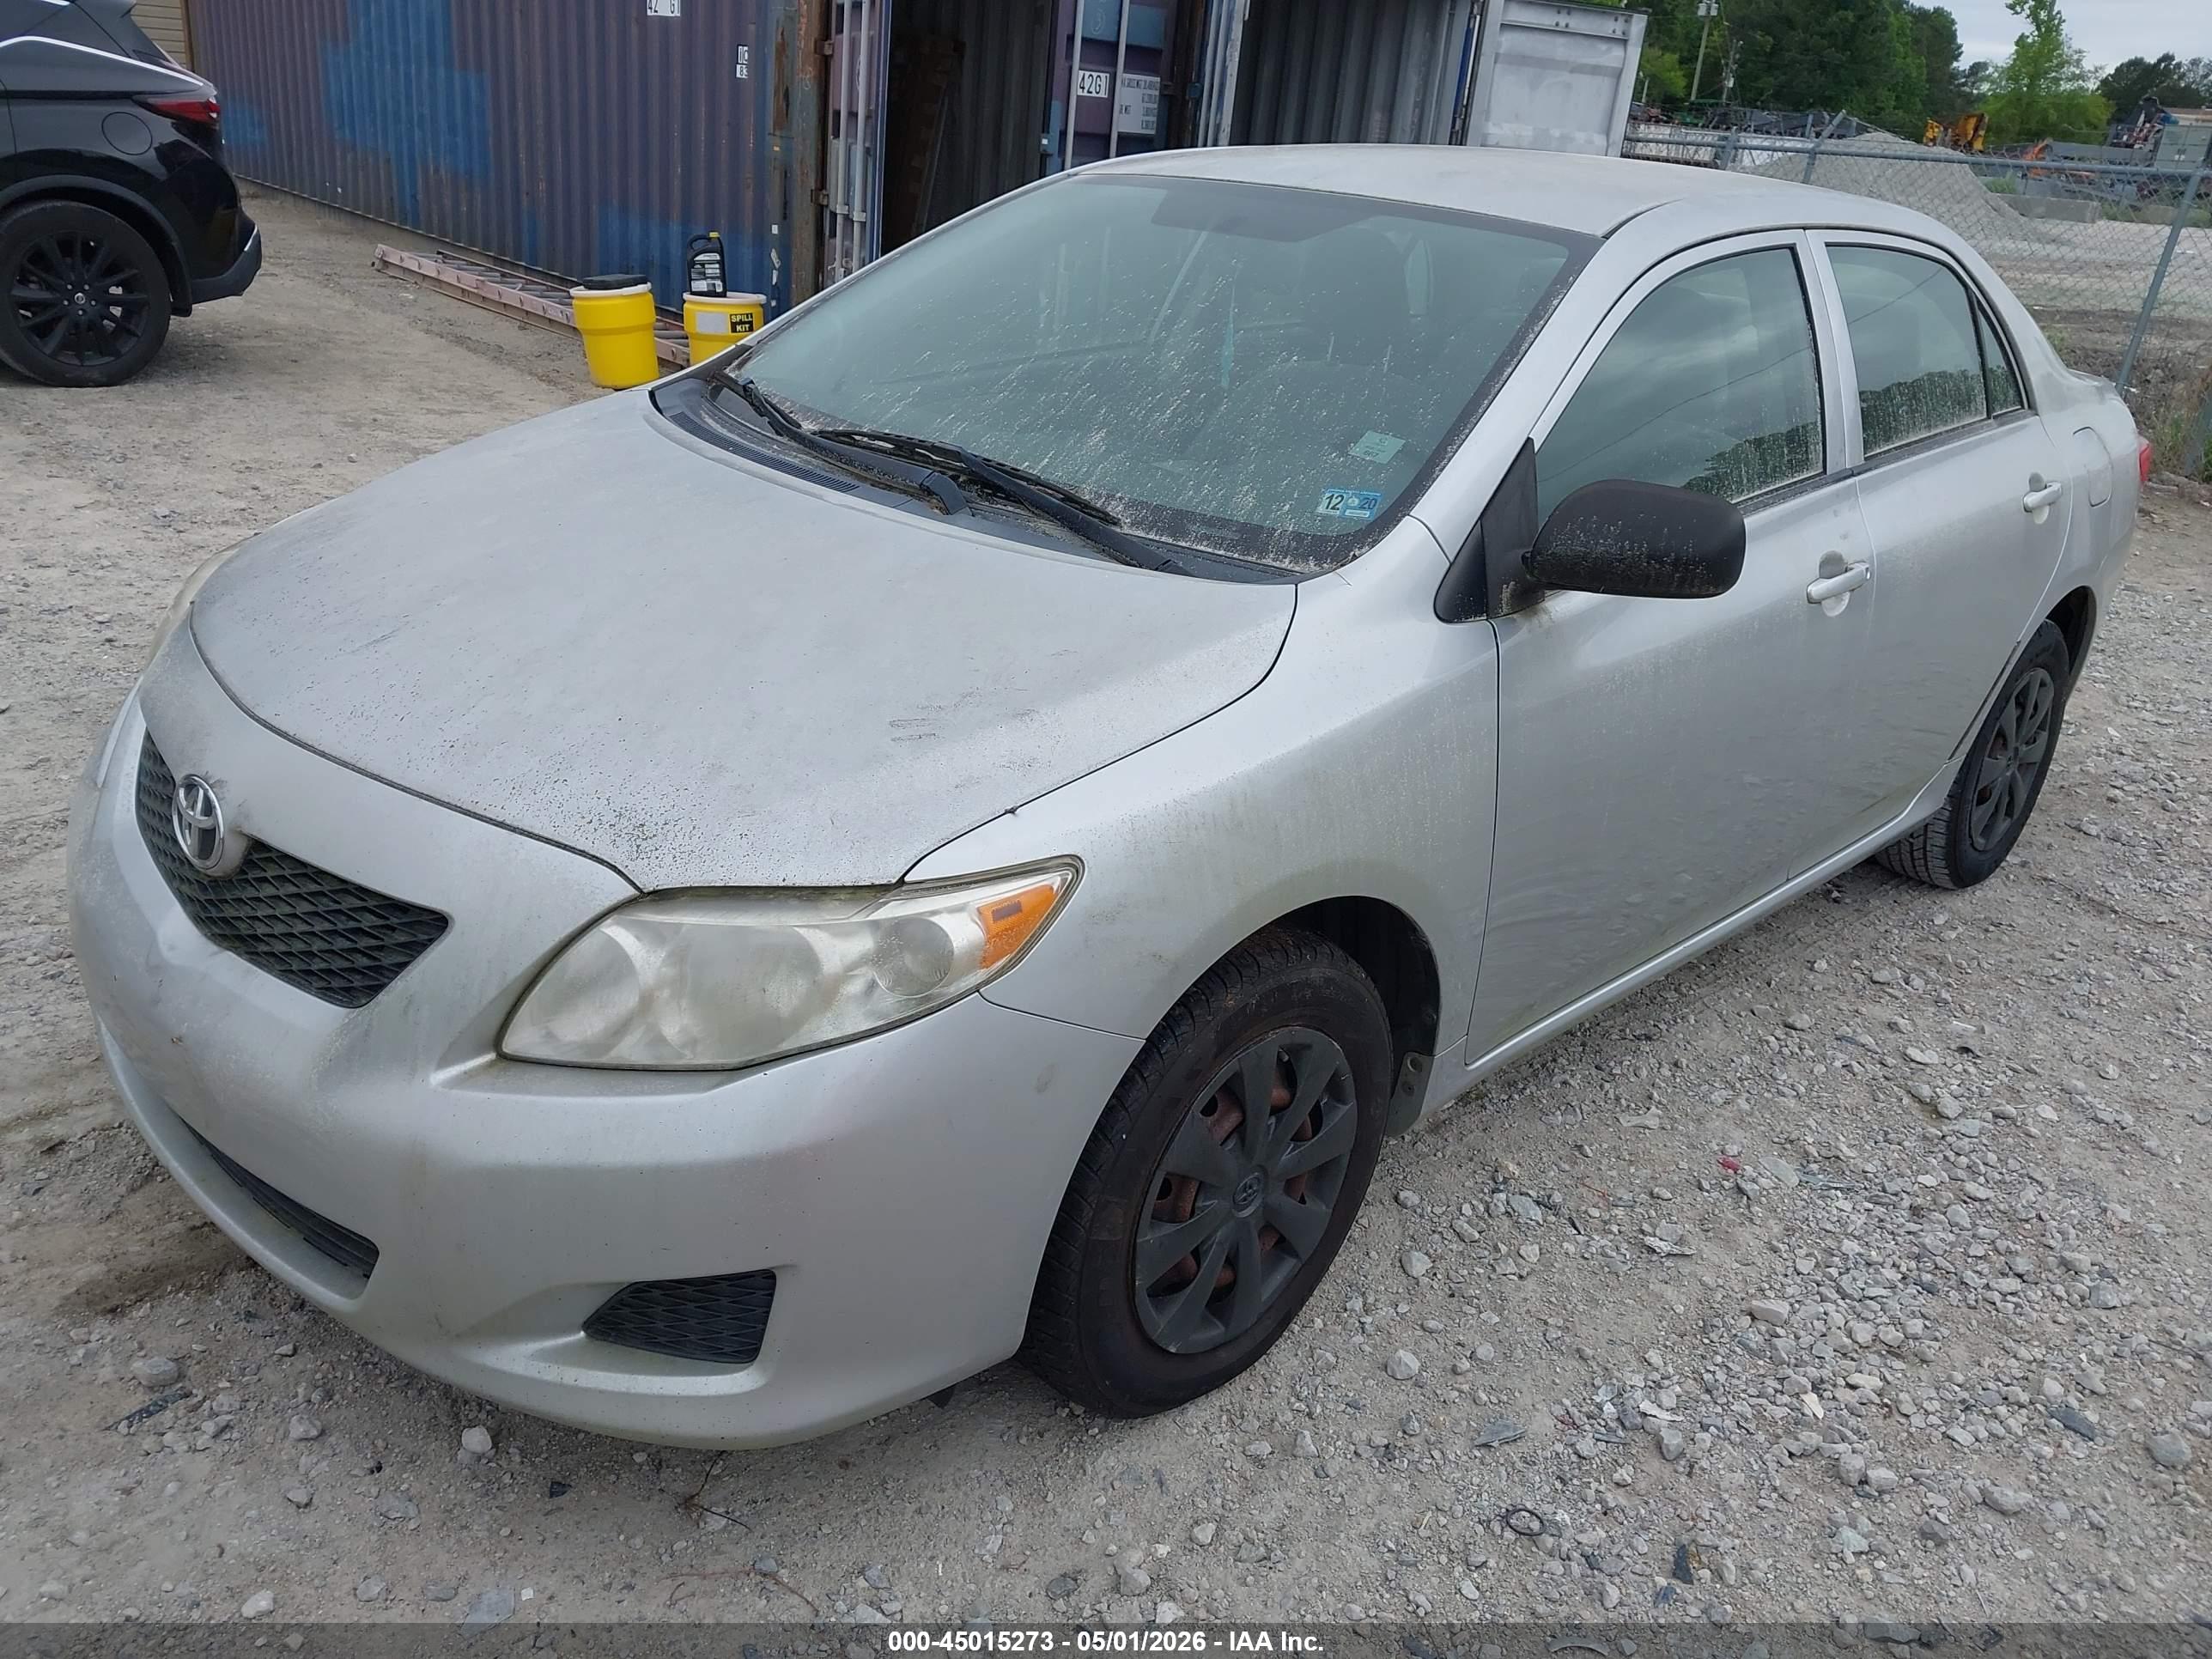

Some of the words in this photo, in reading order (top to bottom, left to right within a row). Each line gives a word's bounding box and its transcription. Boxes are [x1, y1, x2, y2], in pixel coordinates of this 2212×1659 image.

[1079, 72, 1108, 95] 42G1
[731, 314, 753, 323] SPILL
[1325, 494, 1345, 511] 12
[1358, 498, 1378, 509] 20
